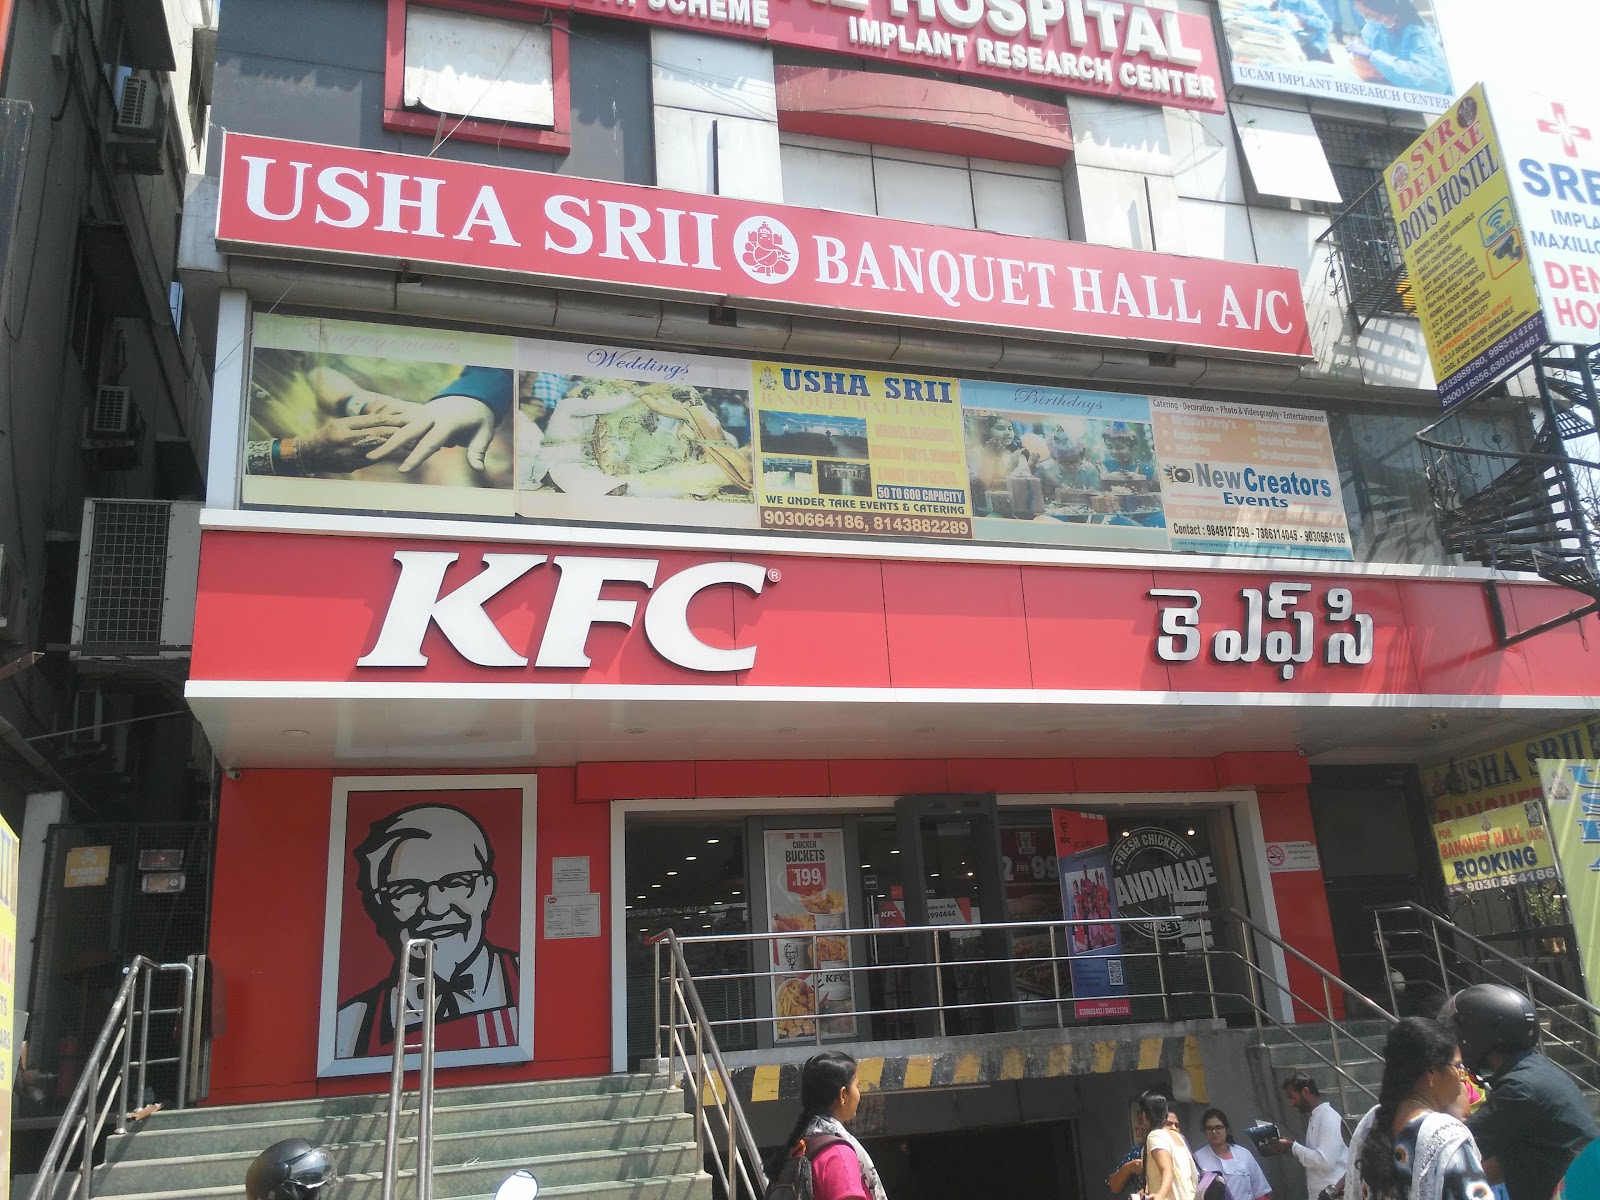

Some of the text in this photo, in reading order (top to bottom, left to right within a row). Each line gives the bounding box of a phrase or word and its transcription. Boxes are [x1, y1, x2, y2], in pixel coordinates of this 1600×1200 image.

[849, 15, 1217, 101] IMPLANT RESEARCH CENTER
[1239, 67, 1450, 109] UCAM IMPLANT RESEARCH CENTER
[1408, 115, 1455, 173] SVR
[1396, 119, 1485, 212] DELUXE
[1398, 140, 1500, 250] BOYS HOSTEL
[241, 156, 1294, 335] USHA SRII BANQUET HALL A/C
[1413, 238, 1429, 256] ROOMS
[1438, 220, 1451, 234] RENT
[1553, 297, 1600, 329] HO
[587, 349, 689, 380] Weddings
[780, 366, 952, 404] USHA SRII
[1015, 388, 1102, 414] Birthdays
[1152, 399, 1178, 410] Catering
[1182, 402, 1214, 412] Decoration
[1219, 405, 1237, 414] Photo
[1242, 407, 1279, 419] Videography
[1282, 411, 1324, 422] Entertainment
[765, 494, 965, 515] WE UNDER TAKE EVENTS & CATERING
[877, 487, 962, 503] 50 TO 600 CAPACITY
[1222, 491, 1288, 508] Events
[763, 509, 969, 535] 9030664186, 8143882289
[1200, 509, 1221, 518] Stop
[1172, 522, 1201, 535] Contact
[1205, 524, 1249, 537] 9849127299
[1255, 528, 1298, 541] 7386114045
[356, 551, 767, 673] KFC
[1116, 837, 1142, 865] FRESH
[1142, 834, 1182, 854] CHICKEN
[1437, 829, 1452, 839] FOR
[1440, 833, 1491, 859] BANQUET
[1494, 826, 1525, 848] HALL
[786, 850, 825, 862] BUCKETS
[1002, 856, 1014, 880] 2
[1454, 846, 1538, 879] BOOKING
[1114, 856, 1218, 907] ANDMADE
[1144, 921, 1171, 932] SICE
[825, 974, 847, 983] KFC
